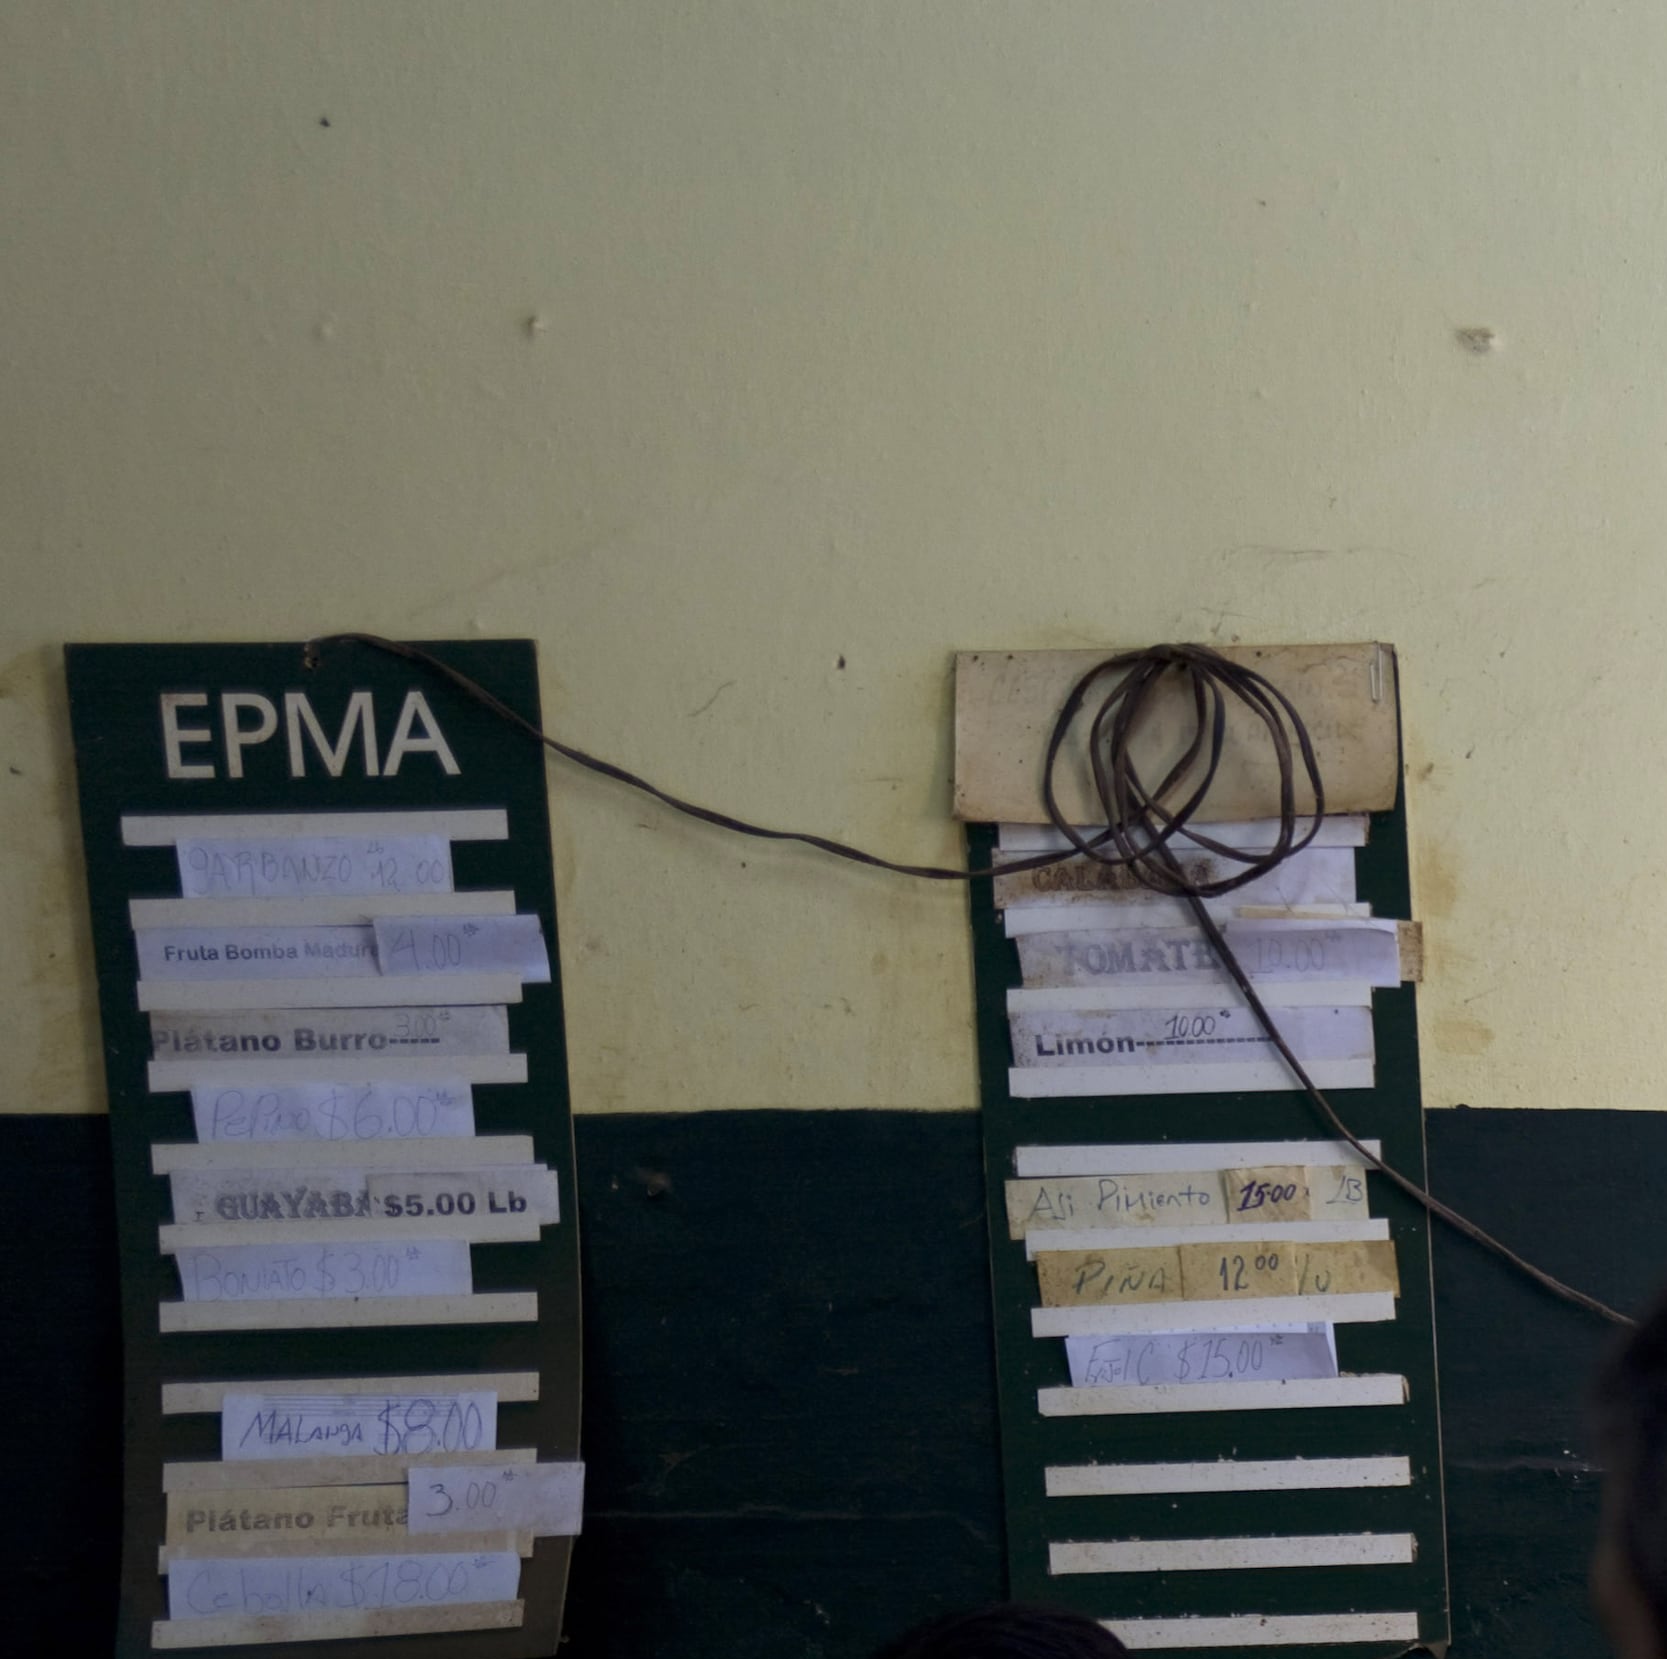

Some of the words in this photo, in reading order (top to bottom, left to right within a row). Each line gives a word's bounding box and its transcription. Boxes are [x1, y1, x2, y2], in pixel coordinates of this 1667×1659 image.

[159, 691, 462, 779] EPMA
[164, 944, 219, 962] Fruta
[225, 943, 298, 961] Bomba
[1055, 938, 1222, 977] TOMATE
[153, 1027, 281, 1055] Plátano
[383, 1191, 476, 1218] $5.00
[488, 1190, 528, 1214] Lb
[426, 1481, 498, 1518] 3.00
[185, 1507, 315, 1534] Plátano
[327, 1503, 409, 1530] Fruta
